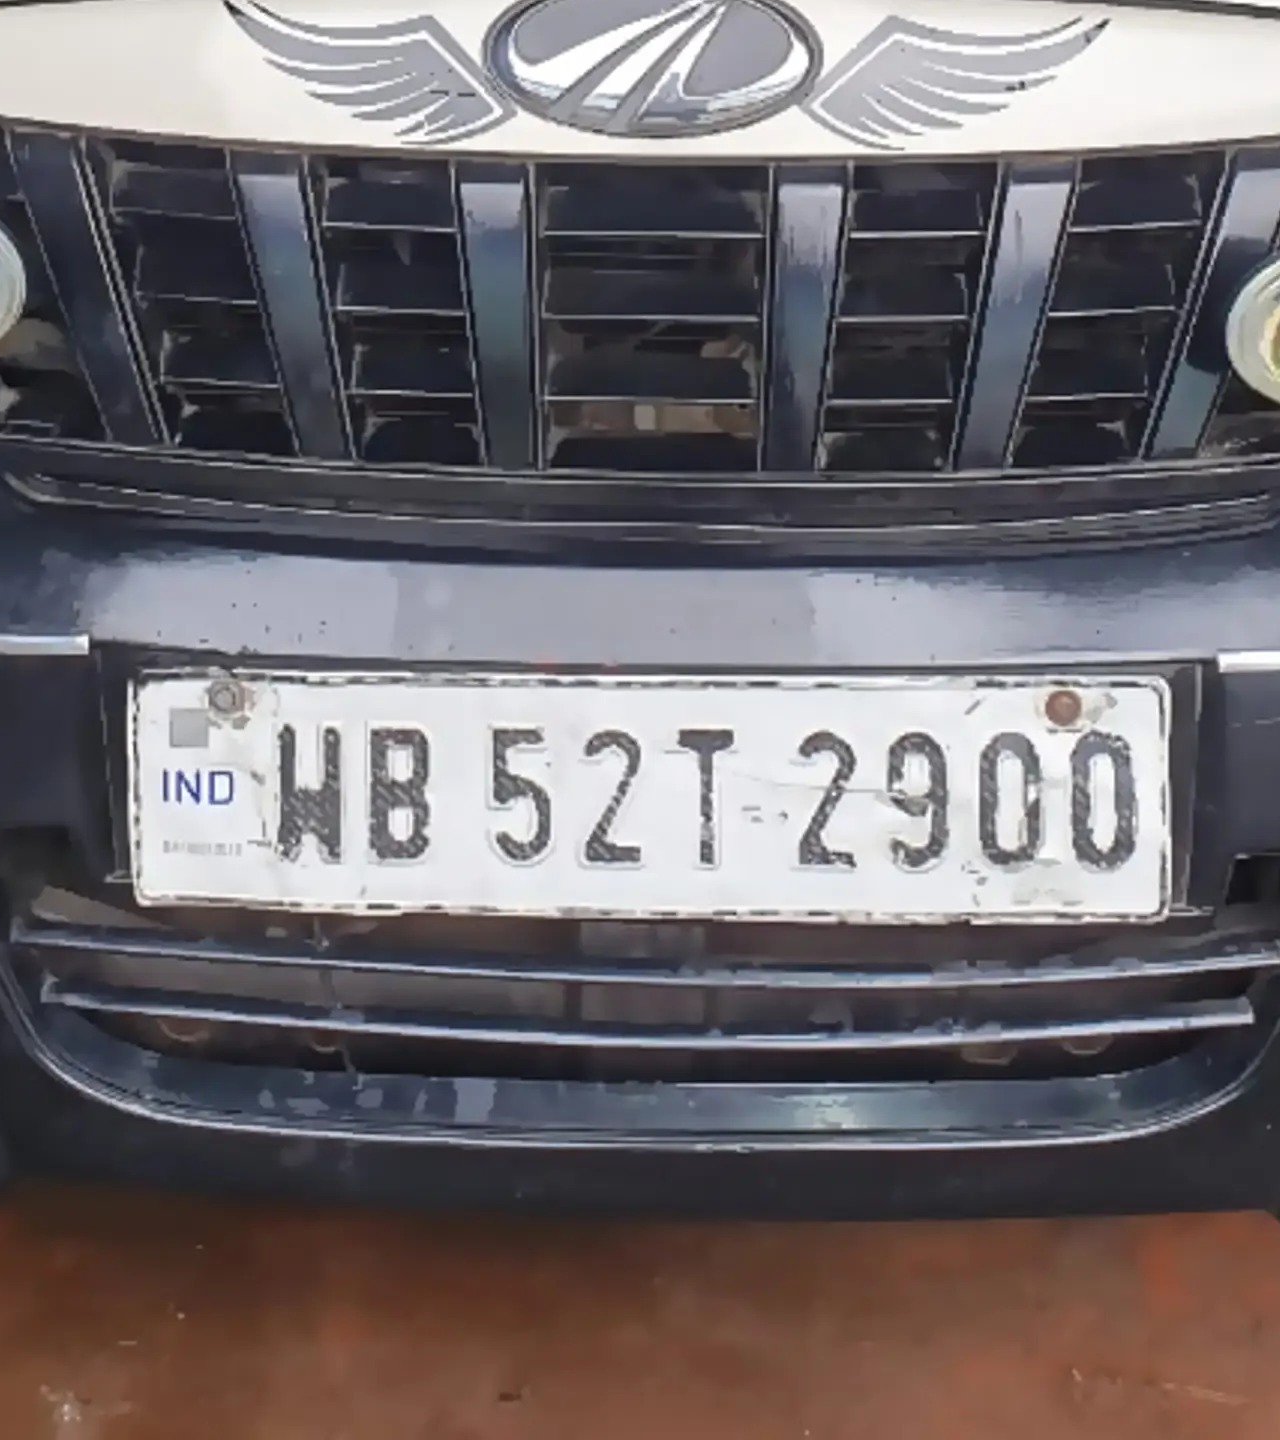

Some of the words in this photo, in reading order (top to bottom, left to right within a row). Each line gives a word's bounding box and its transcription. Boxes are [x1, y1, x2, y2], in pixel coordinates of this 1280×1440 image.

[160, 768, 236, 806] IND
[276, 723, 432, 862] WB
[797, 728, 1138, 870] 2900
